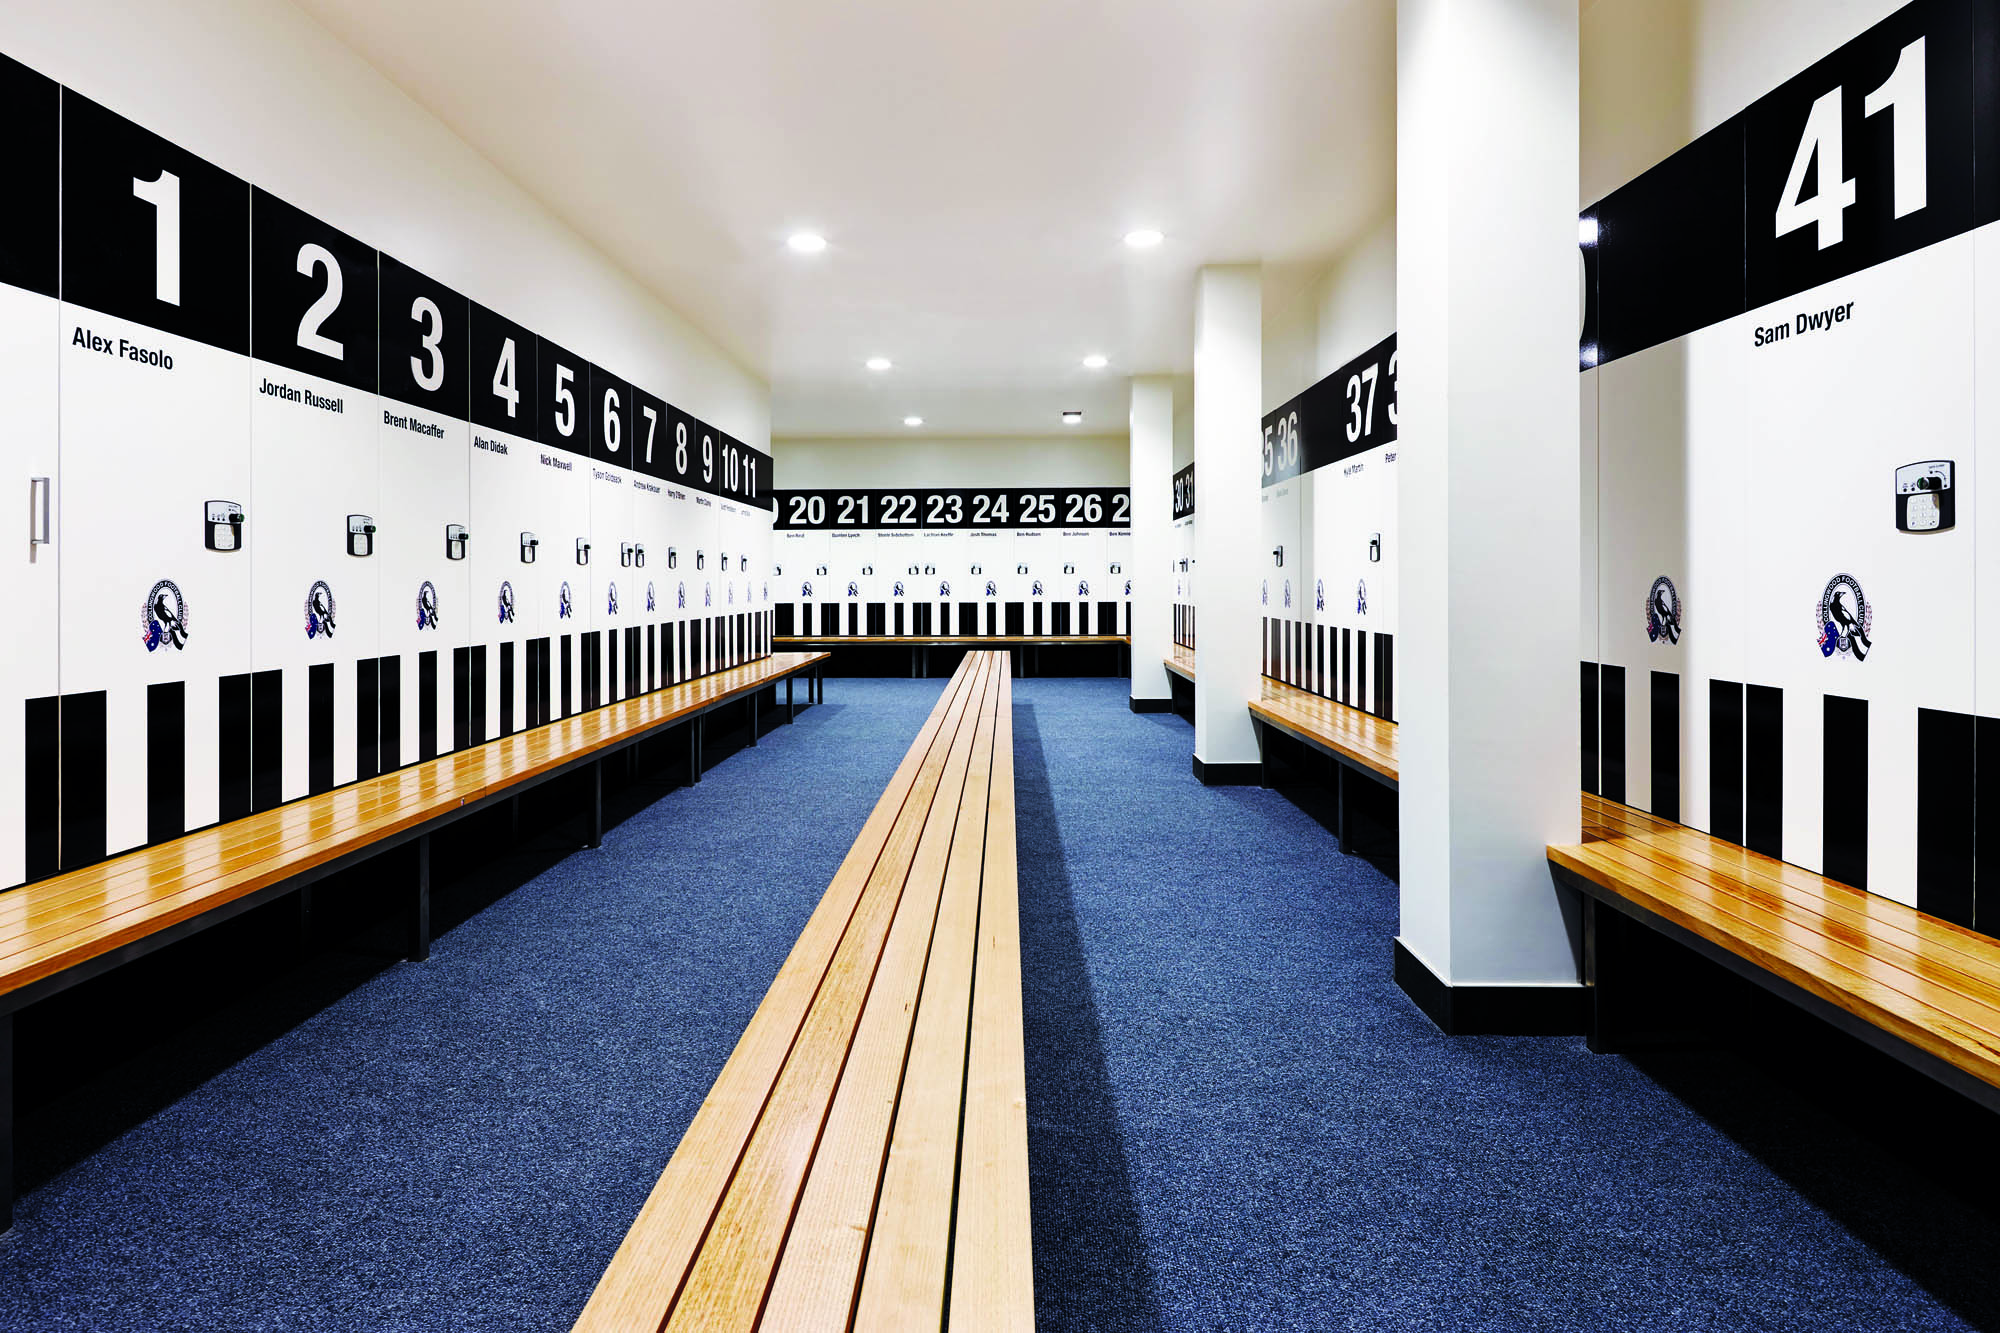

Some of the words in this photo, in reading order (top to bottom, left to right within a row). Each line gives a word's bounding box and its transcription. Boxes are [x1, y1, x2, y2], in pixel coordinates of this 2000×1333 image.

[1775, 35, 1927, 252] 41
[133, 169, 180, 307] 1
[296, 243, 344, 361] 2
[1754, 320, 1790, 348] Sam
[1796, 301, 1855, 335] Dwyer
[72, 326, 114, 356] Alex
[120, 340, 174, 370] Fasolo
[410, 296, 445, 392] 3
[259, 378, 302, 404] Jordan
[304, 388, 344, 414] Russell
[492, 337, 520, 418] 4
[555, 363, 576, 437] 5
[383, 410, 407, 429] Brent
[409, 417, 445, 439] Macaffer
[603, 387, 621, 453] 6
[1346, 362, 1378, 443] 37
[473, 436, 489, 451] Alan
[490, 440, 508, 455] Didak
[643, 405, 657, 464] 7
[675, 422, 688, 475] 8
[1262, 425, 1274, 478] 5
[1277, 411, 1298, 471] 36
[540, 454, 552, 467] Nick
[702, 435, 713, 483] 9
[722, 444, 739, 492] 10
[743, 454, 756, 498] 11
[789, 496, 826, 525] 20
[837, 495, 869, 524] 21
[880, 495, 917, 524] 22
[926, 494, 963, 524] 23
[972, 494, 1010, 523] 24
[1019, 494, 1056, 523] 25
[1065, 494, 1103, 523] 26
[1175, 479, 1184, 513] 30
[1185, 470, 1194, 509] 31
[164, 581, 182, 603] FOOTBALL
[1823, 576, 1841, 622] COLLINGWOOD
[1841, 575, 1863, 604] FOOTBALL
